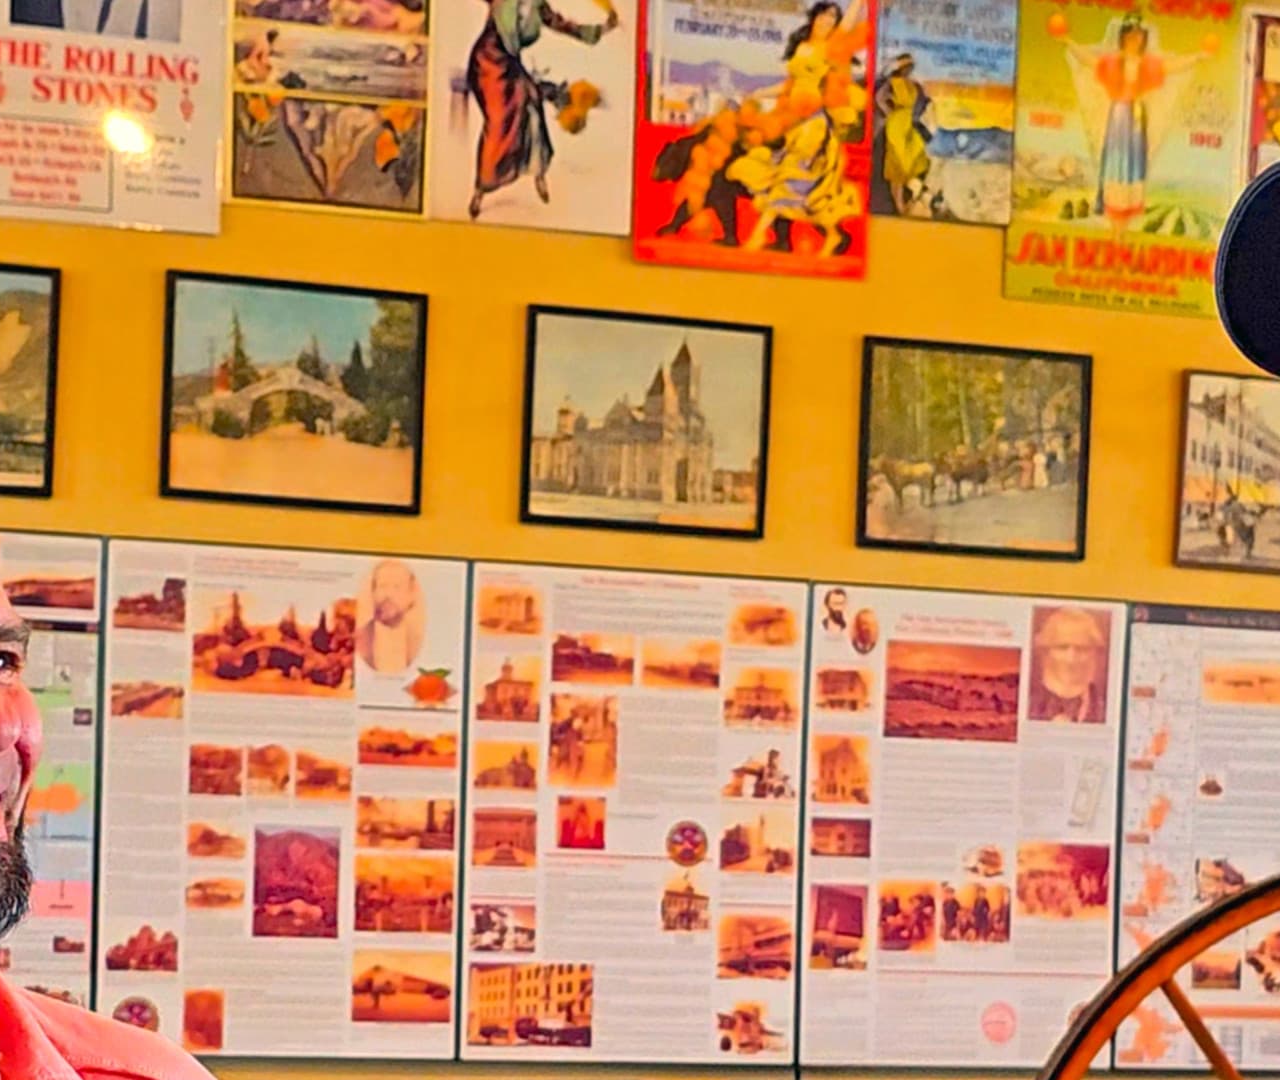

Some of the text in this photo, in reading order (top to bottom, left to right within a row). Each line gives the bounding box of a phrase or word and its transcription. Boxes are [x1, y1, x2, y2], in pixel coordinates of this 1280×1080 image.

[64, 45, 200, 85] ROLLING
[31, 75, 158, 113] STONES
[1012, 231, 1216, 281] SAN BERNARDIN
